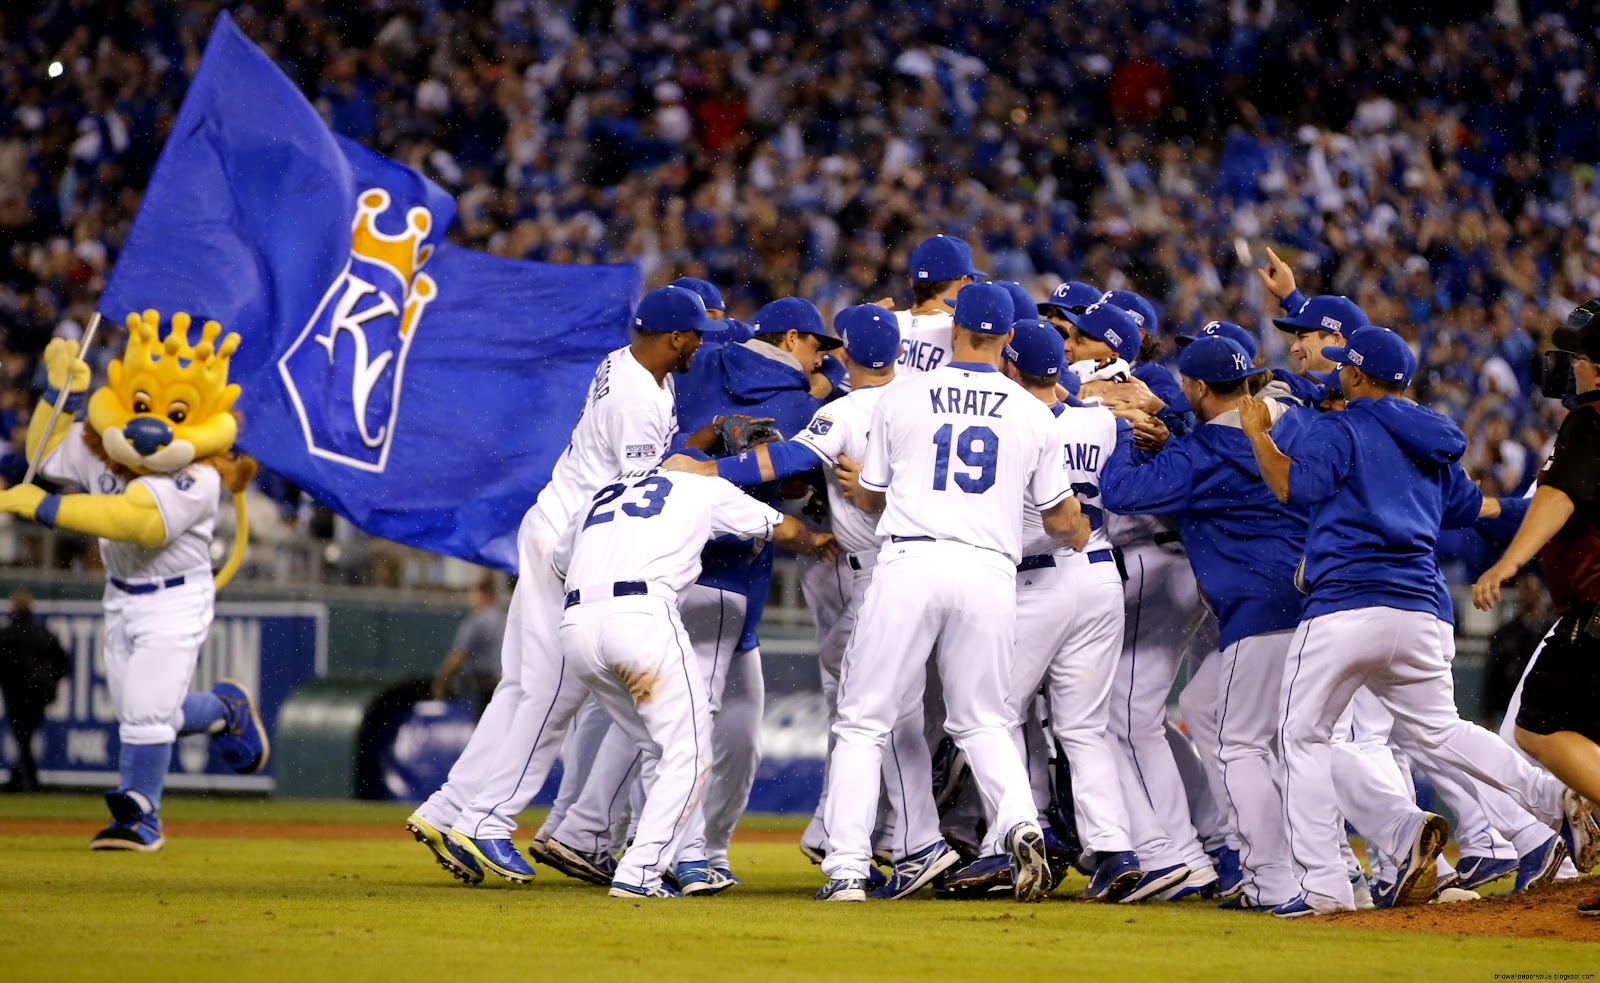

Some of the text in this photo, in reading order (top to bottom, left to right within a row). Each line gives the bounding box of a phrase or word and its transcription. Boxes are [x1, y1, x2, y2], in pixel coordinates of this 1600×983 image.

[929, 386, 1008, 418] KRATZ
[932, 423, 999, 494] 19
[582, 475, 674, 533] 23
